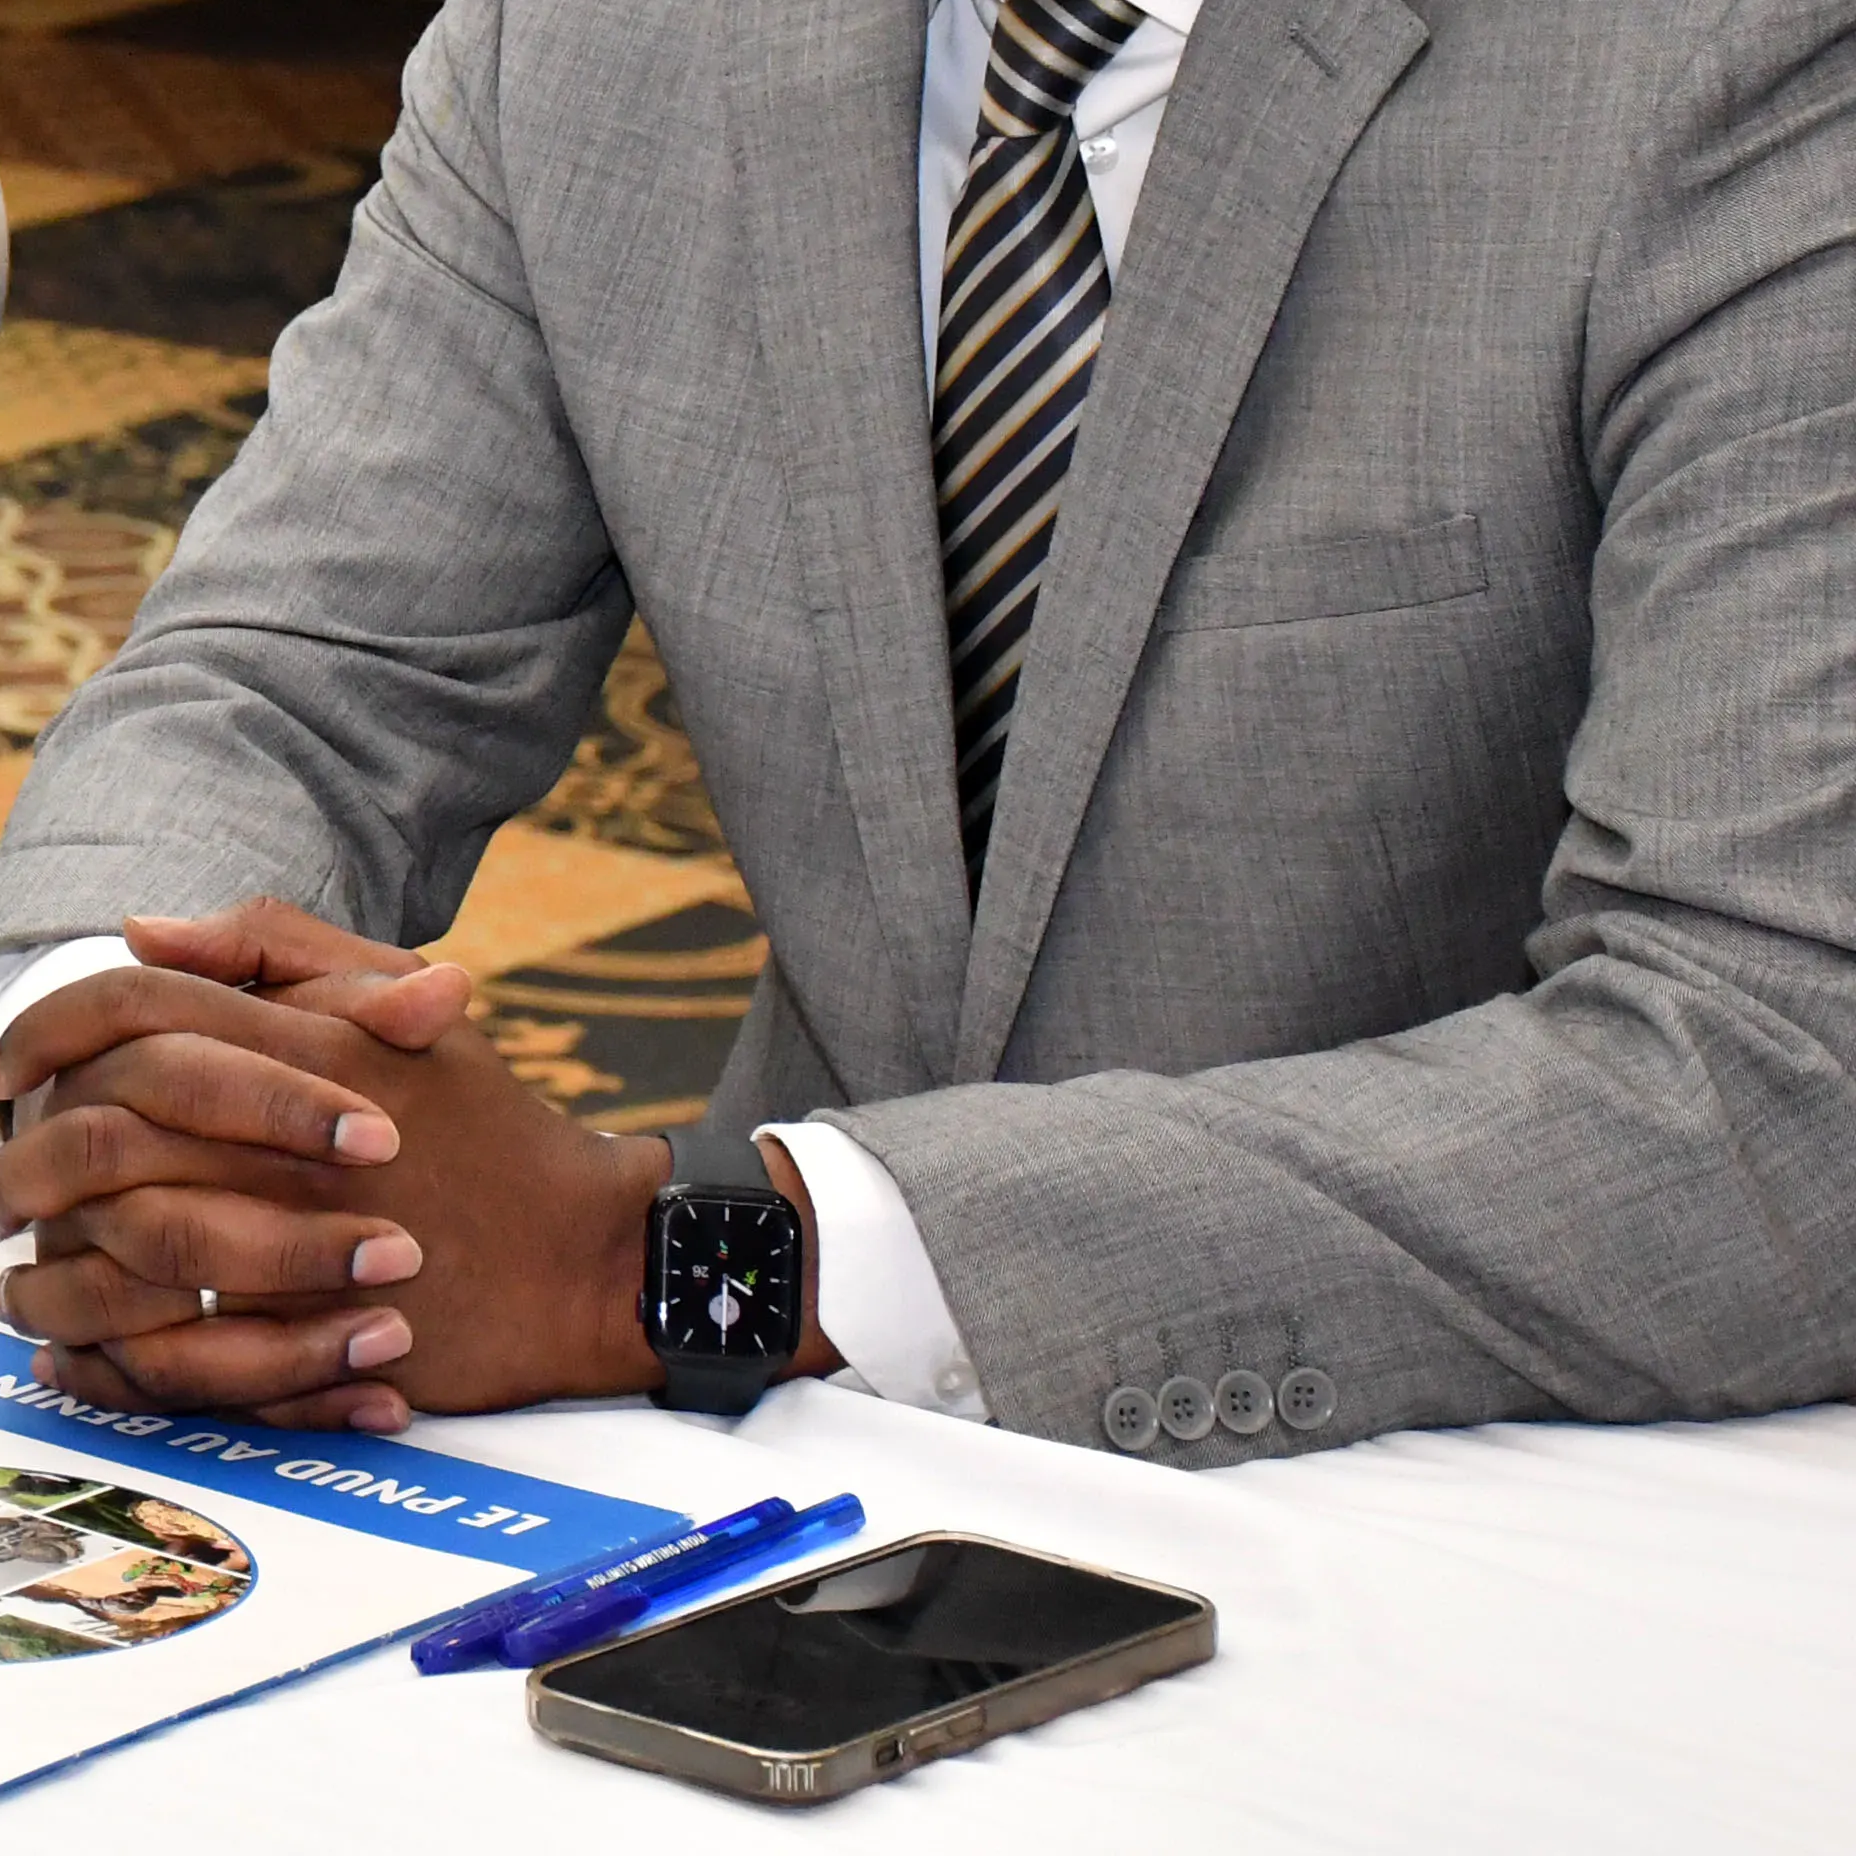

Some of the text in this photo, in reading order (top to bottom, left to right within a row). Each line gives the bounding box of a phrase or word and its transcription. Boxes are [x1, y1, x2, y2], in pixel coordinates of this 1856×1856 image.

[168, 1433, 281, 1462] AU
[274, 1458, 467, 1515] PNUD
[458, 1503, 550, 1536] LE
